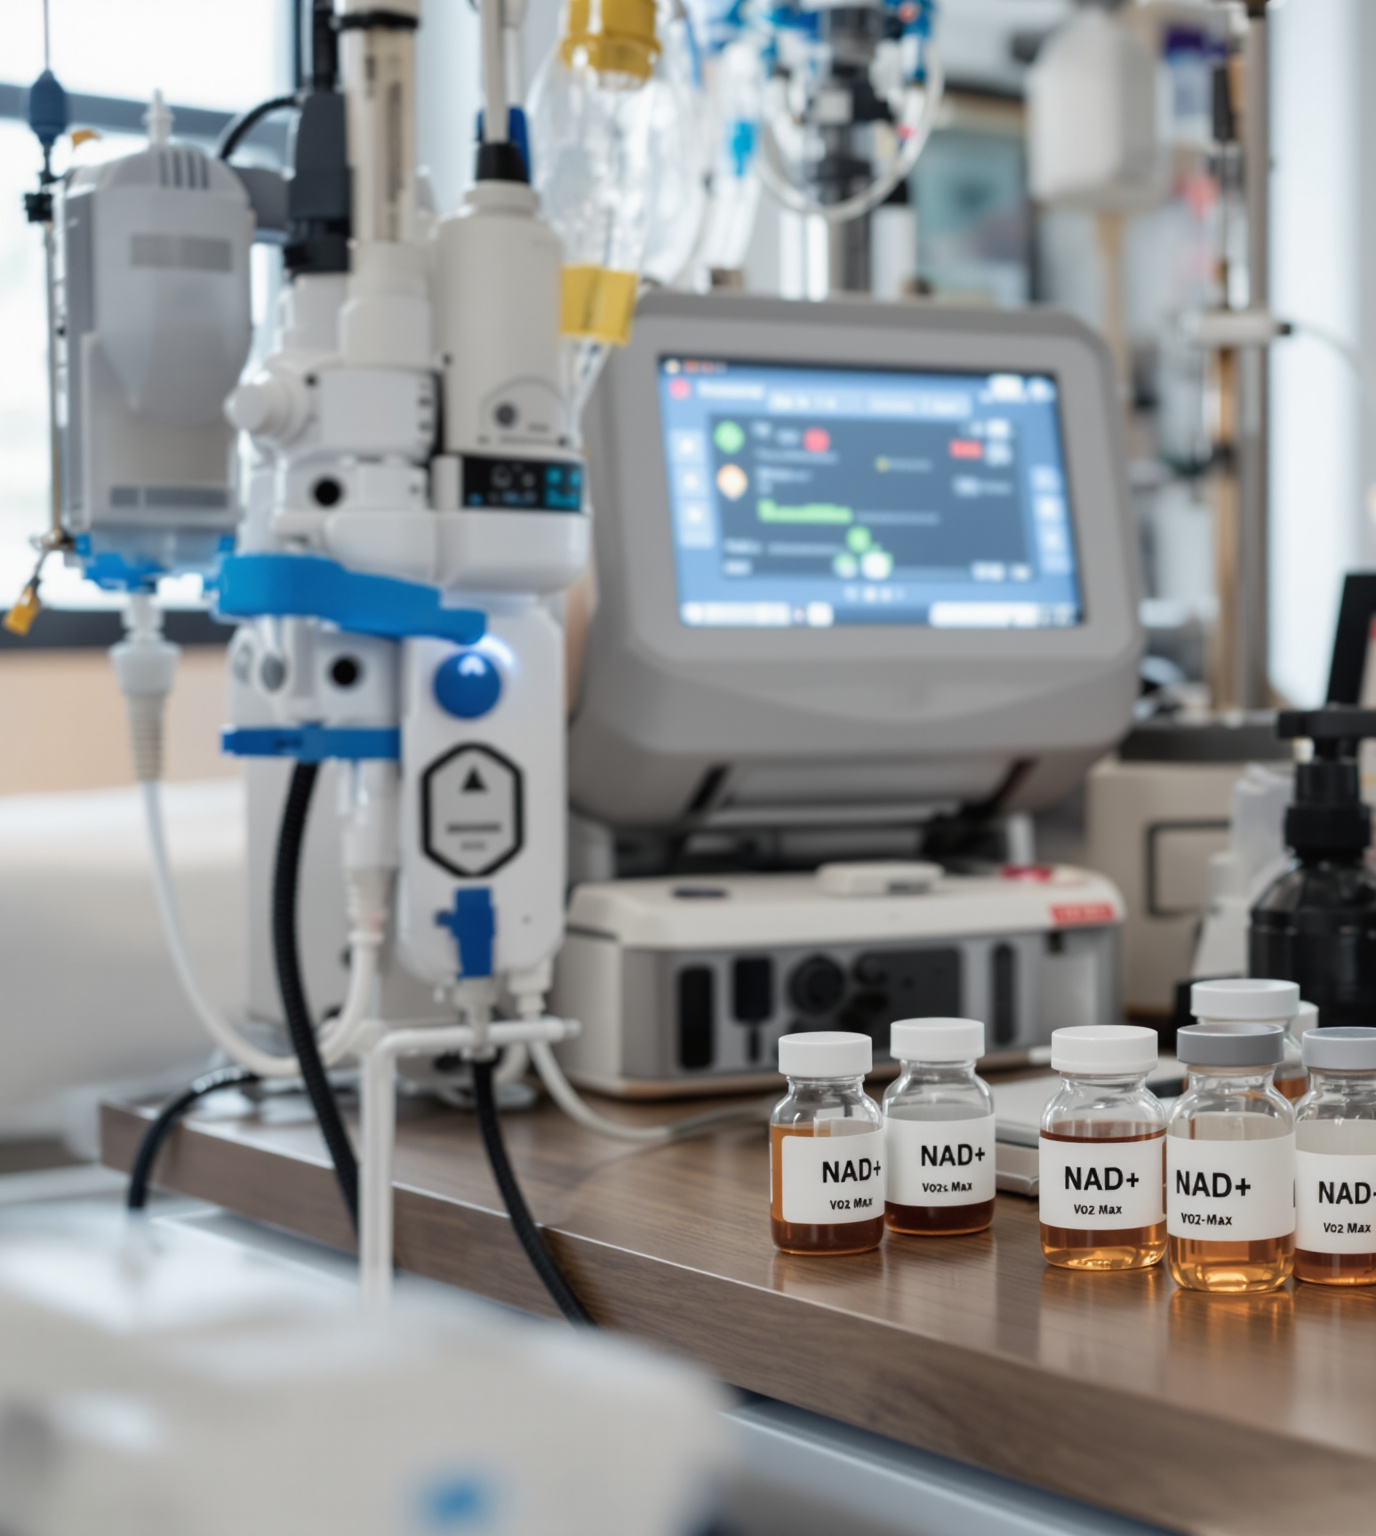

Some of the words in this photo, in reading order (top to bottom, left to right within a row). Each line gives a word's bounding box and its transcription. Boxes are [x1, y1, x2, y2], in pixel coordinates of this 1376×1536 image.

[922, 1143, 986, 1167] NAD+
[822, 1157, 882, 1184] NAD+
[1064, 1165, 1140, 1191] NAD+
[1176, 1169, 1251, 1198] NAD+
[1098, 1204, 1122, 1216] Max
[1346, 1222, 1372, 1234] Max
